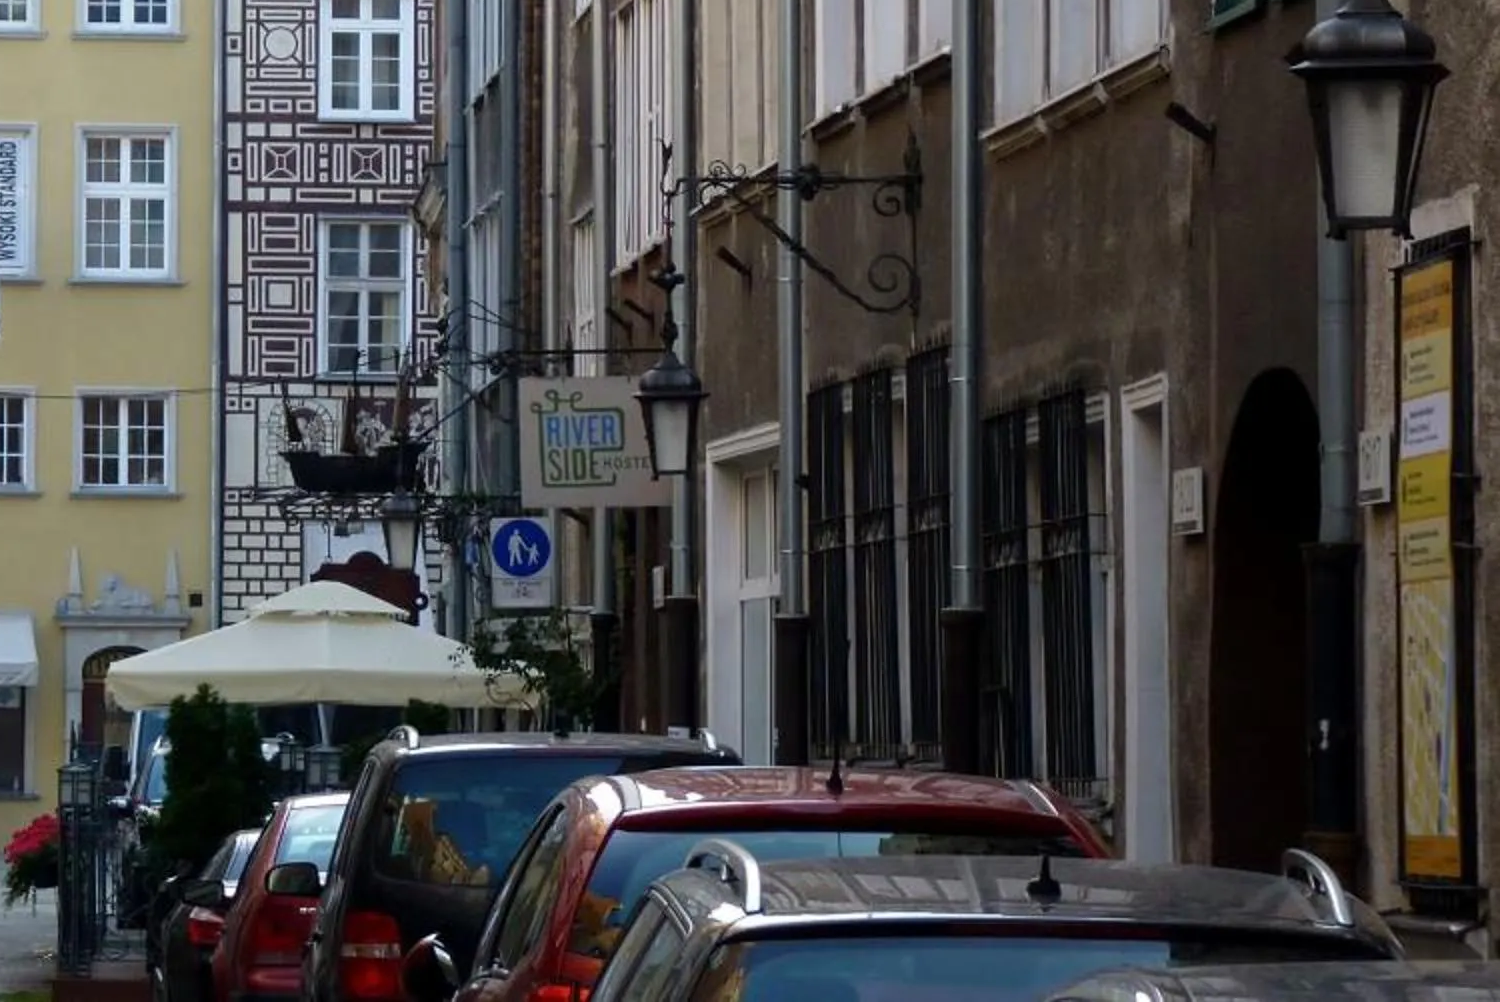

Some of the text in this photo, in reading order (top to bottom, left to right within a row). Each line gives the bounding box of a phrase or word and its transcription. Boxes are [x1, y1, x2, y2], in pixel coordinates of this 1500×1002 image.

[547, 415, 616, 447] RIVER
[549, 448, 651, 482] SIDE HOSTE
